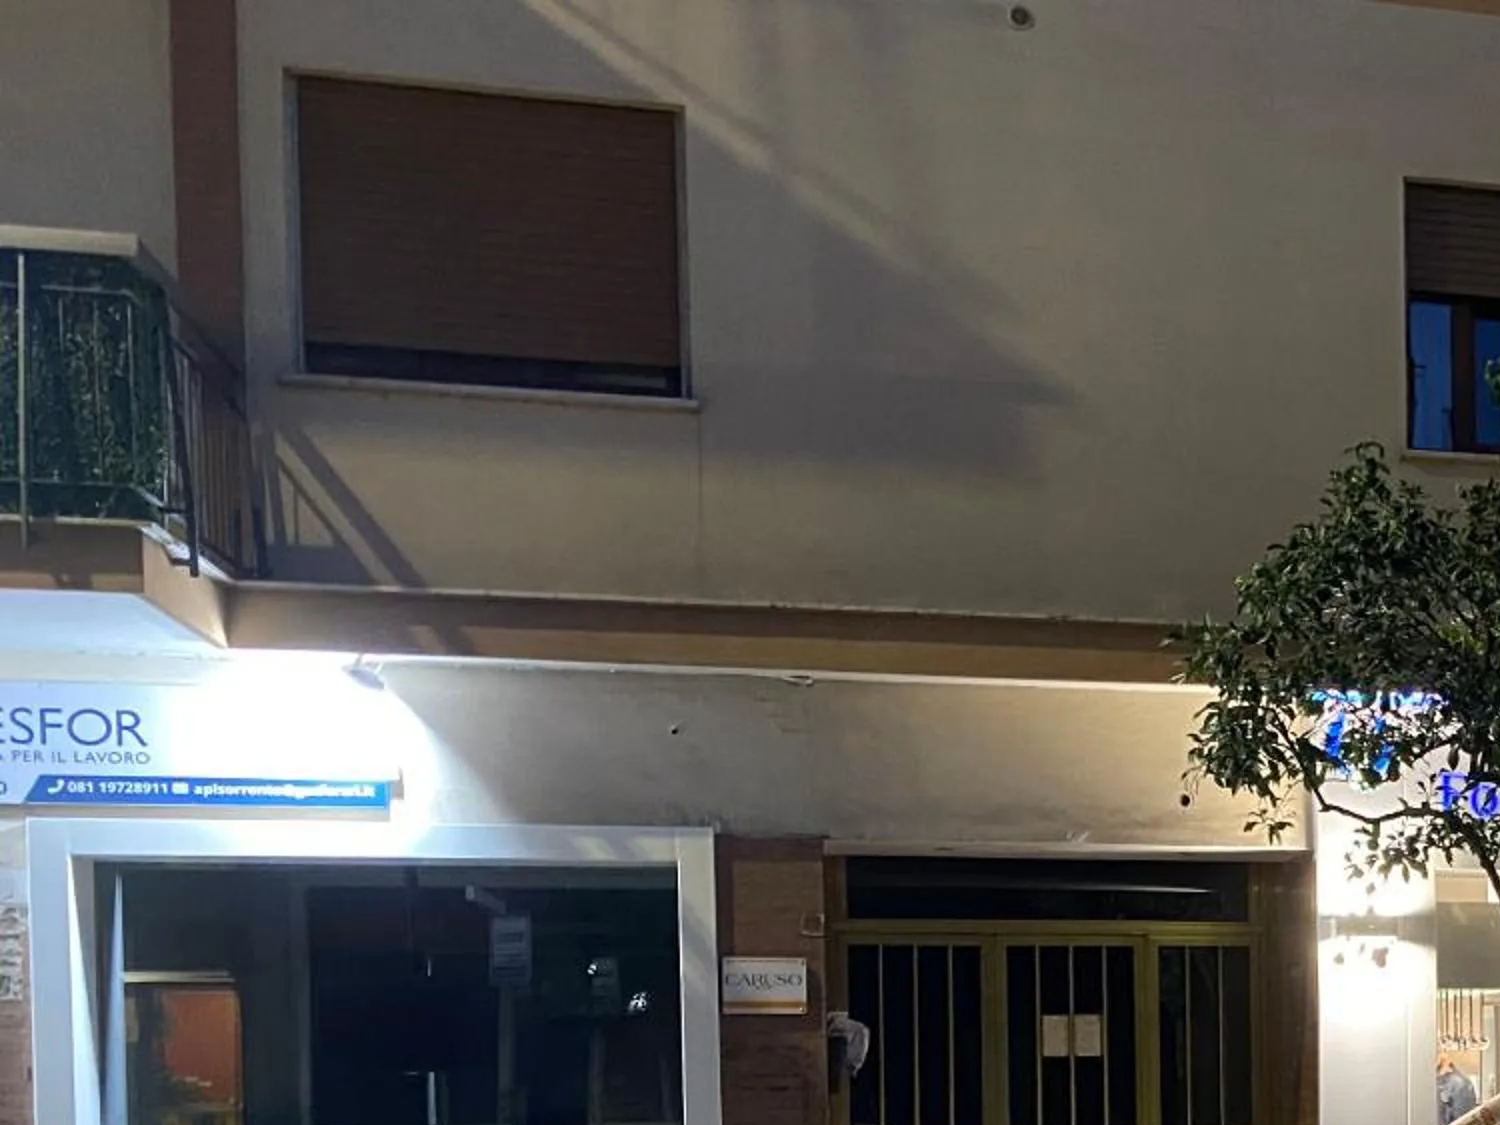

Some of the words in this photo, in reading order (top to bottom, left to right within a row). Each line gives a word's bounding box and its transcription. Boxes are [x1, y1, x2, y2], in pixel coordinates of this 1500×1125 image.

[0, 706, 148, 747] SFOR
[11, 750, 44, 763] PER
[51, 751, 67, 764] IL
[73, 751, 151, 765] LAVORO
[67, 780, 94, 794] 081
[99, 781, 168, 796] 19728911
